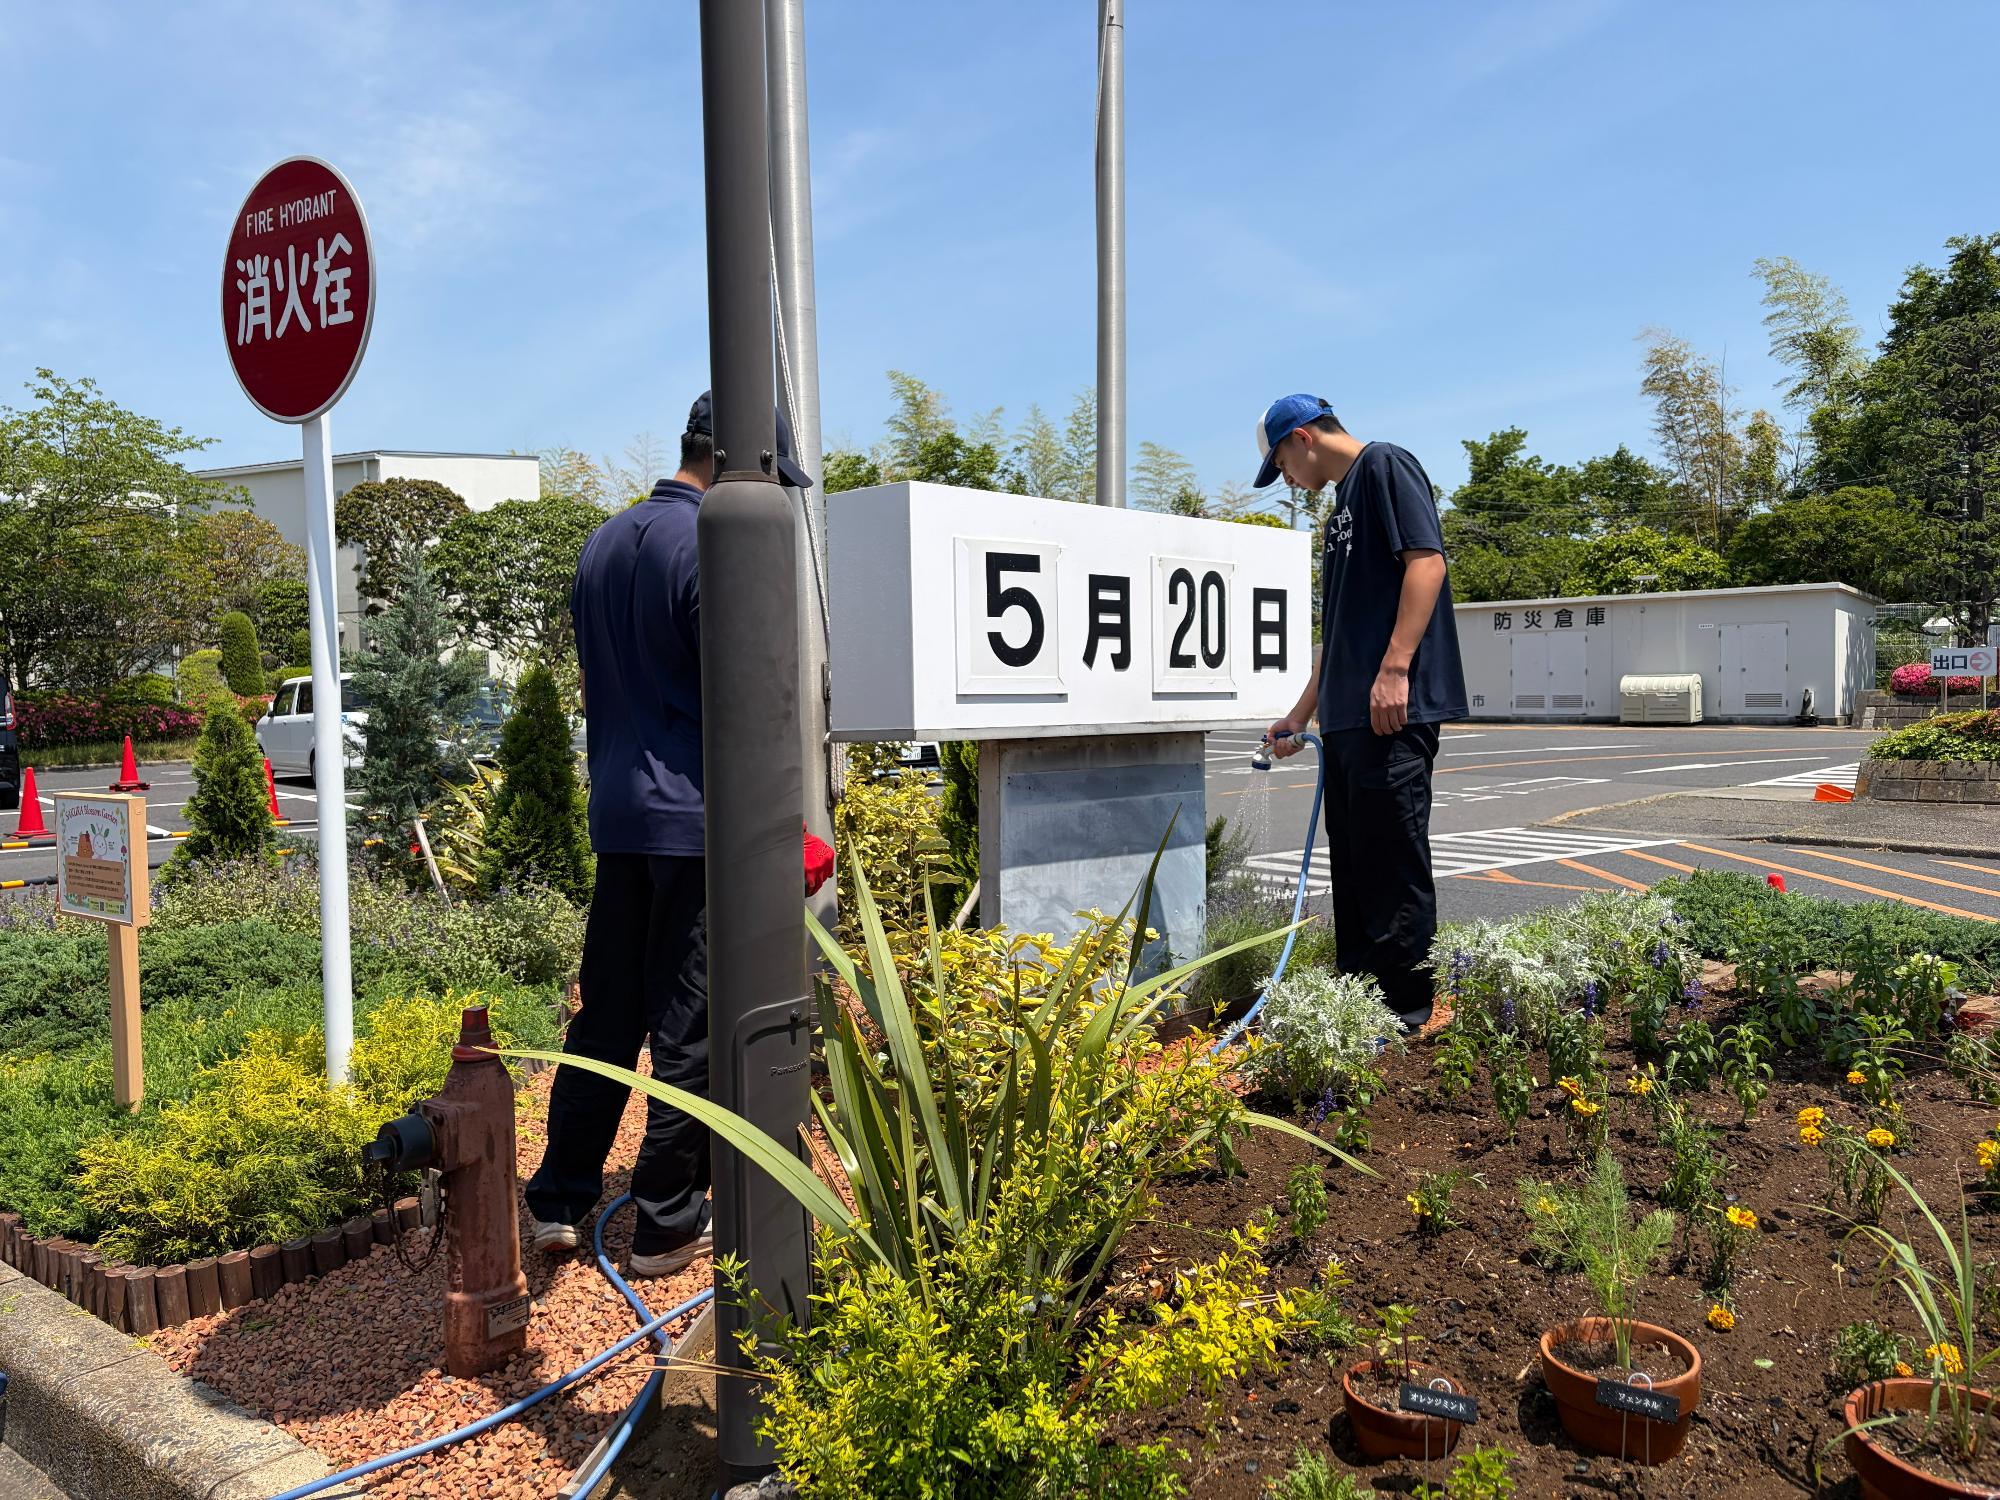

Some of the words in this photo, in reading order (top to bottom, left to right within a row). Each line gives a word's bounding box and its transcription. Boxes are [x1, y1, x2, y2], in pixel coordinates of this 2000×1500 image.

[246, 207, 274, 238] FIRE
[279, 189, 337, 228] HYDRANT
[236, 232, 353, 346] 消火栓
[1494, 606, 1606, 631] 防災倉庫
[1933, 655, 1968, 670] 出口
[64, 805, 84, 821] SAKURA
[1410, 1391, 1467, 1414] オレンジミント
